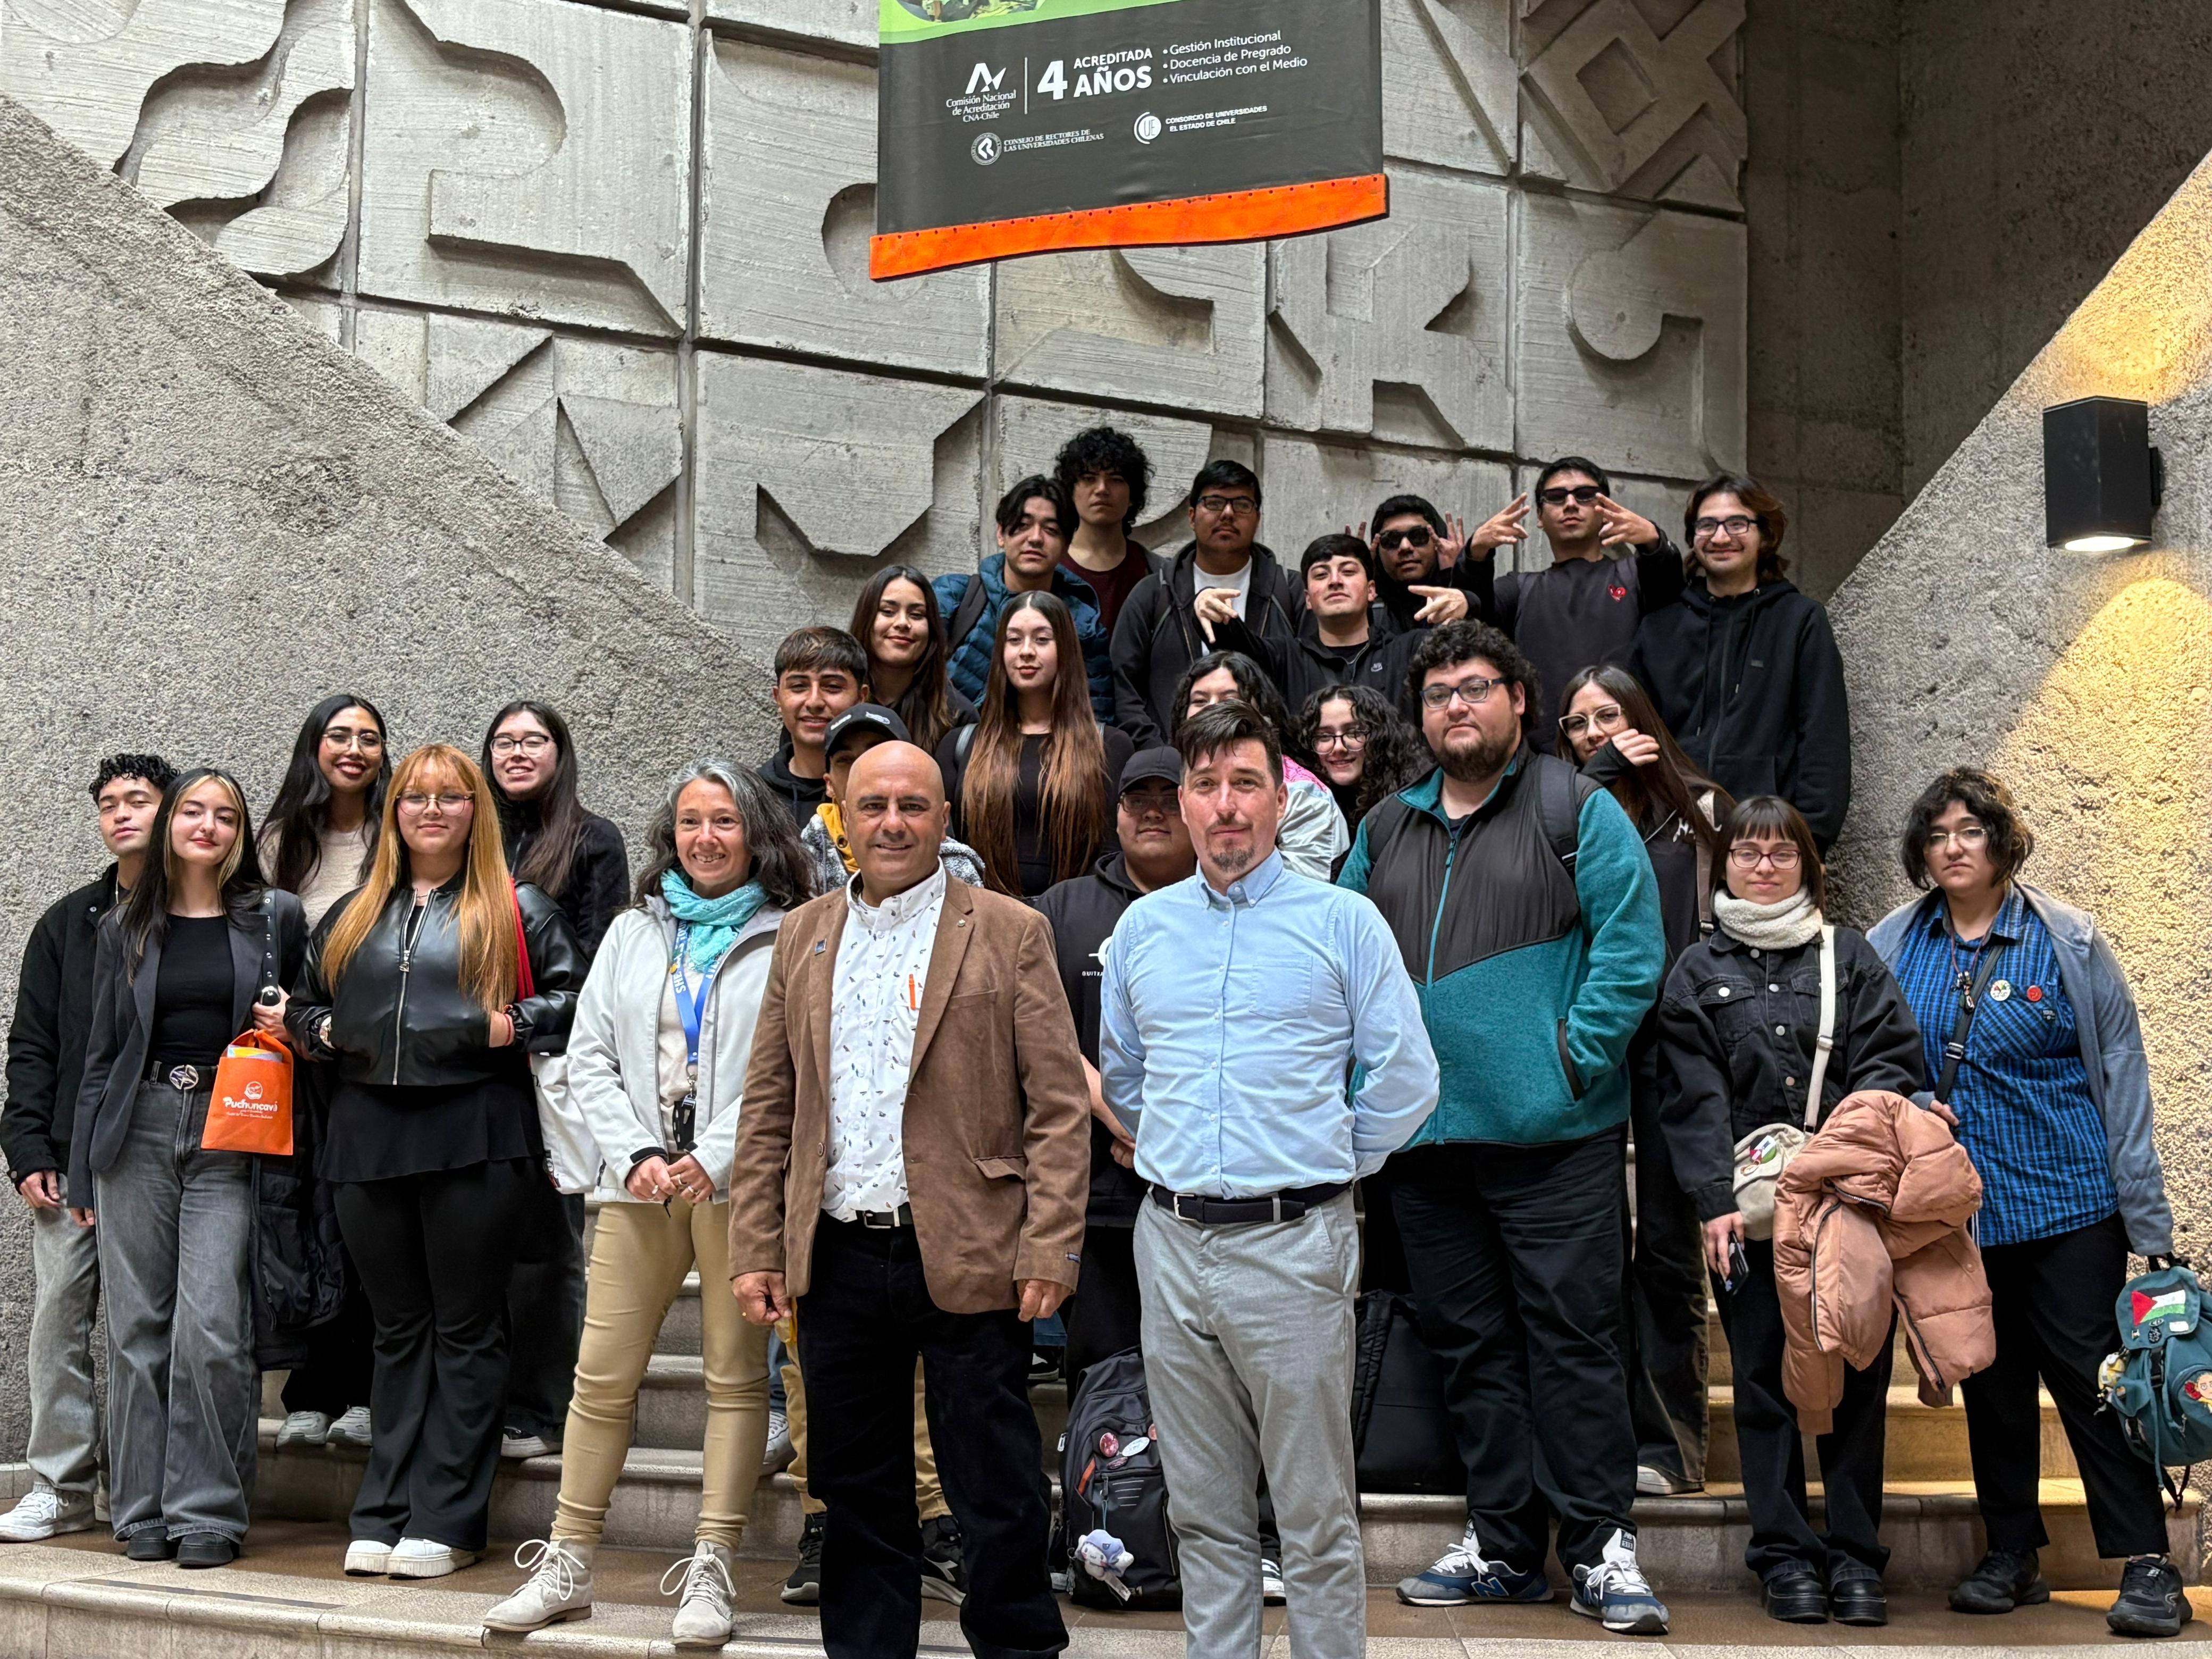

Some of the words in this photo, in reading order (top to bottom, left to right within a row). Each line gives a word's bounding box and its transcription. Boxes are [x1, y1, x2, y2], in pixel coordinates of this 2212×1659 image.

[1169, 41, 1211, 55] Gestión
[1214, 30, 1281, 48] Institucional
[1073, 48, 1153, 69] ACREDITADA
[1170, 54, 1221, 70] Docencia
[1224, 52, 1238, 62] de
[1241, 45, 1292, 60] Pregrado
[1037, 60, 1068, 100] 4
[1073, 65, 1153, 98] AÑOS
[1169, 67, 1233, 84] Vinculación
[1235, 64, 1257, 75] con
[1260, 61, 1270, 72] el
[1272, 57, 1308, 70] Medio
[945, 95, 981, 108] Comisión
[983, 89, 1016, 103] Nacional
[952, 107, 961, 116] de
[963, 100, 1010, 114] Acreditación
[962, 111, 1000, 123] CNA-Chile
[1166, 113, 1204, 124] CONSORCIO
[1215, 105, 1268, 118] UNIVERSIDADES
[1179, 122, 1205, 131] ESTADO
[1003, 136, 1034, 146] CONSEJO
[1045, 130, 1079, 141] RECTORES
[1003, 144, 1017, 153] LAS
[1018, 138, 1070, 151] UNIVERSIDADES
[1070, 133, 1104, 144] CHILENAS
